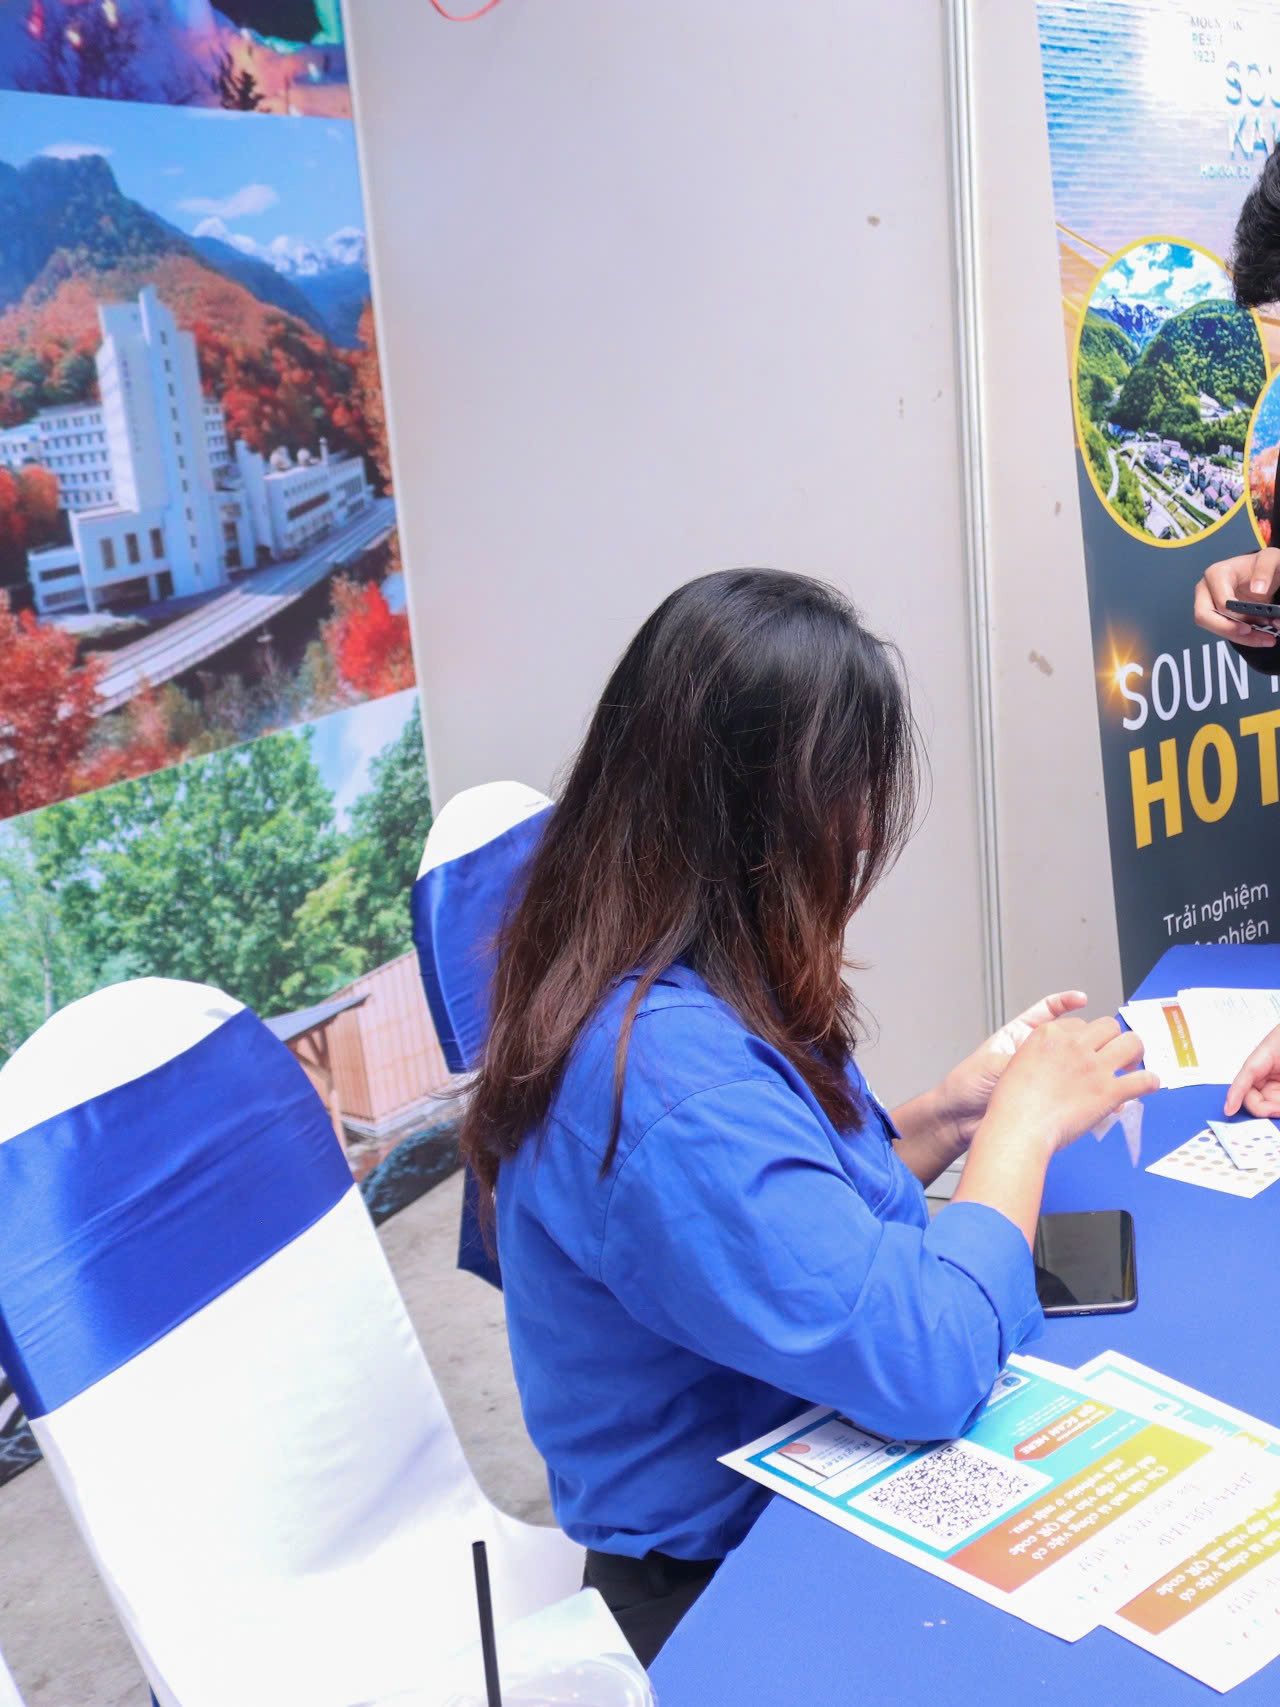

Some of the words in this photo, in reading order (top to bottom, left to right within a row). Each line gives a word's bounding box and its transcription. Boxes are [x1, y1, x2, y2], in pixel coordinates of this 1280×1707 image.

[1119, 640, 1249, 731] SOUN
[1163, 904, 1197, 936] Trải
[1201, 883, 1269, 922] nghiệm
[821, 1440, 871, 1470] Register
[1036, 1521, 1061, 1537] QR
[1008, 1535, 1037, 1555] code
[1184, 1560, 1211, 1577] QR
[1155, 1574, 1186, 1597] code
